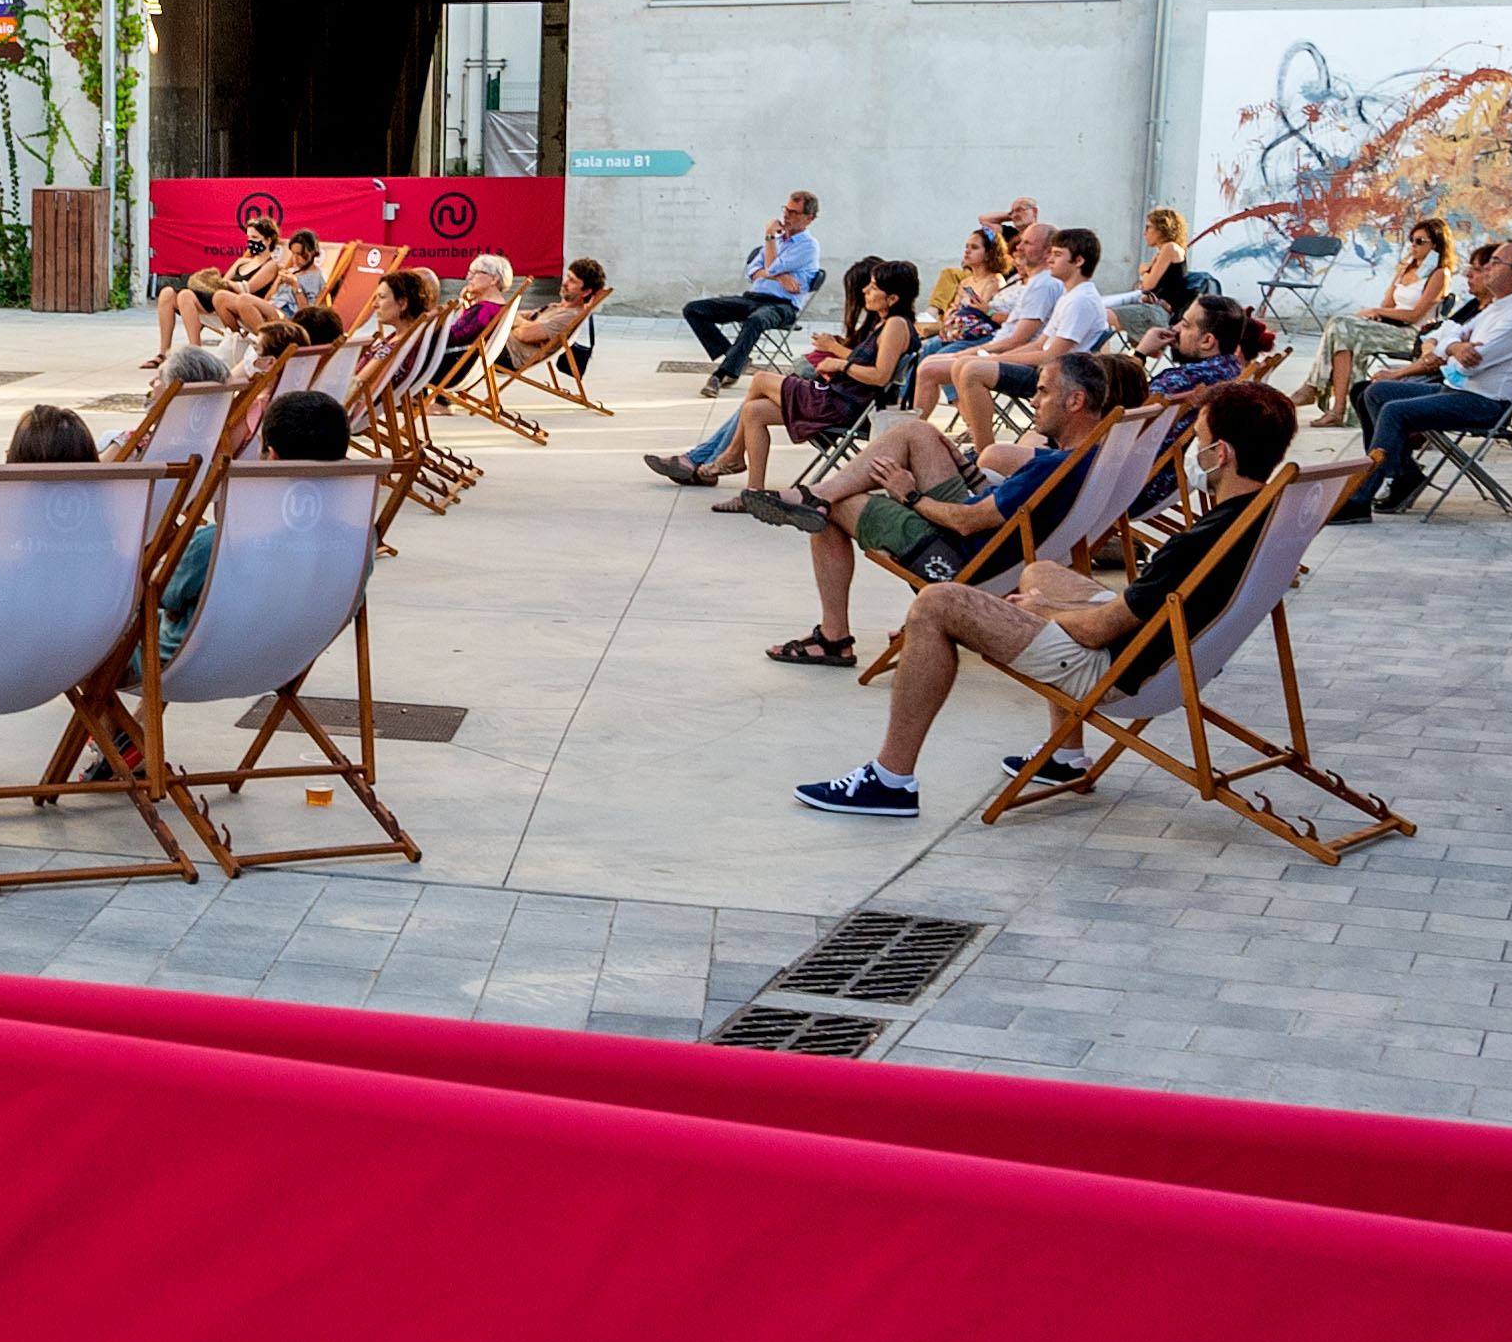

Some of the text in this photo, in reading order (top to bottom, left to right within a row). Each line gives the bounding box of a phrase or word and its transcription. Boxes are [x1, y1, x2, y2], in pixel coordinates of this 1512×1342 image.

[575, 155, 651, 168] sala nau B1
